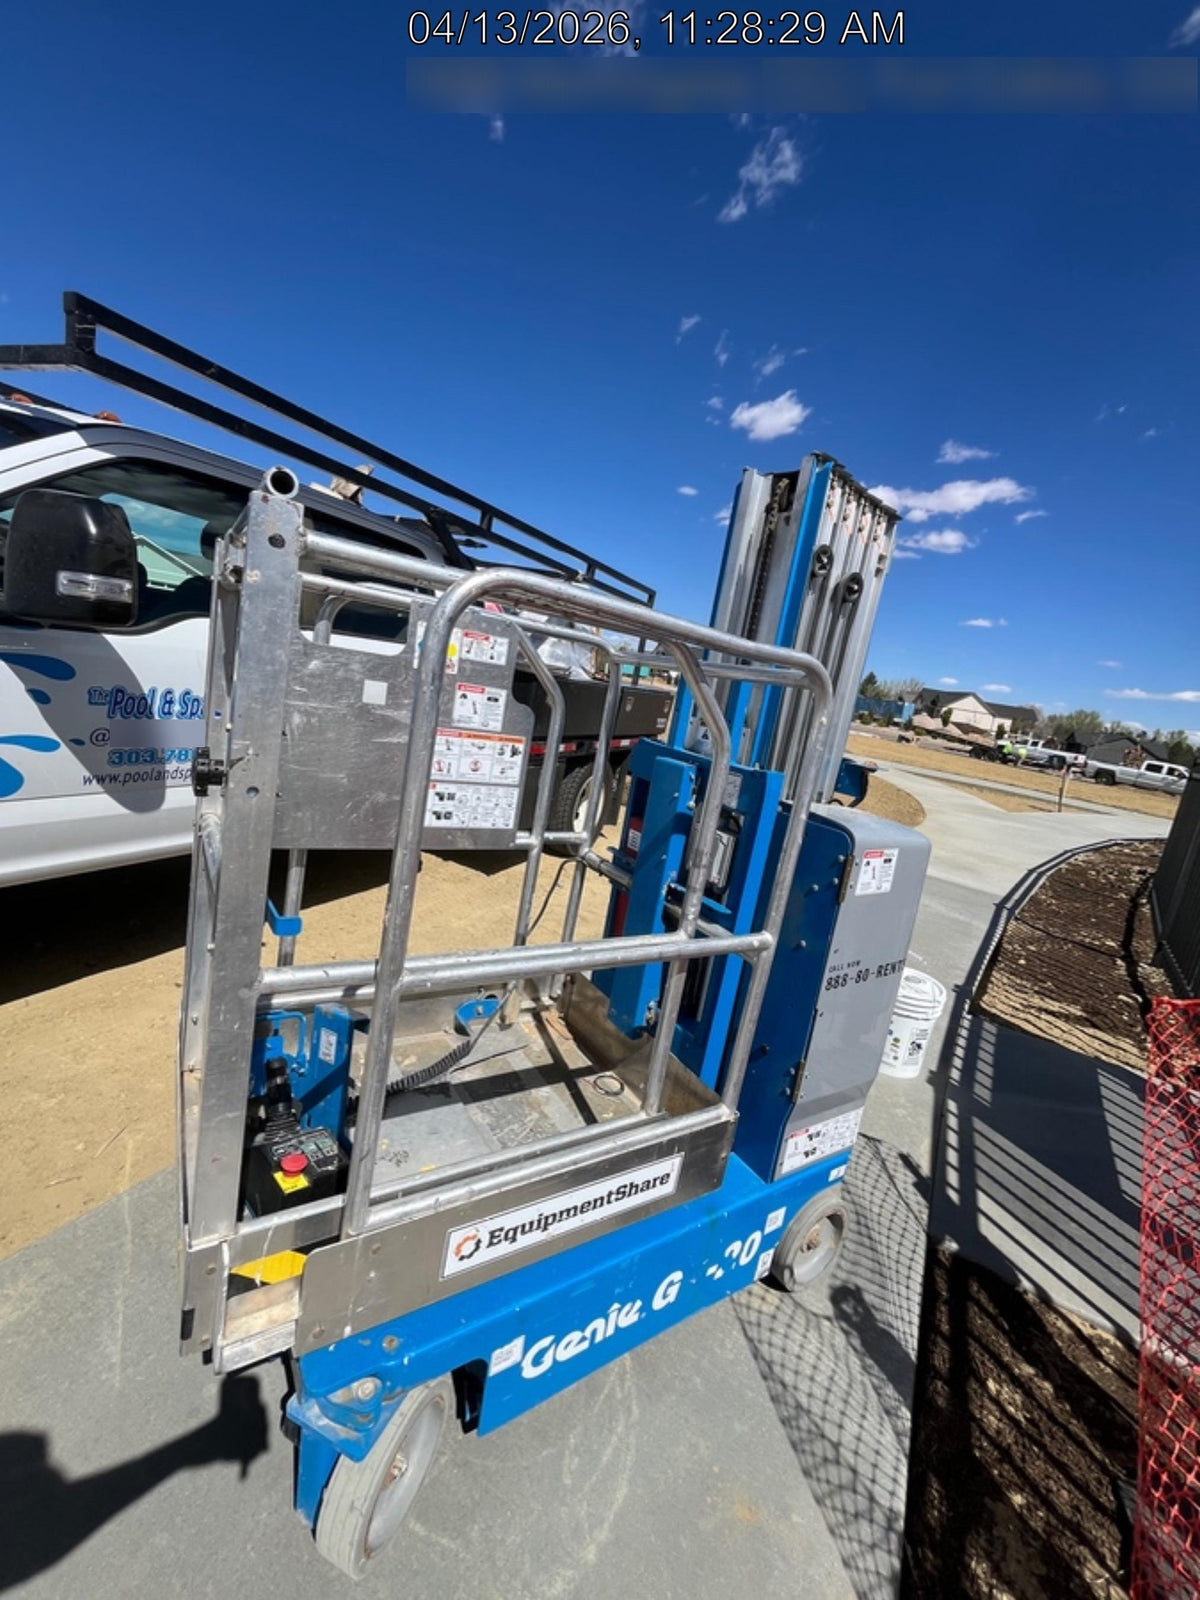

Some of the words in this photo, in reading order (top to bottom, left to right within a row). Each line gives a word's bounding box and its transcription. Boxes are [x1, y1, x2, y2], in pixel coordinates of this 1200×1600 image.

[112, 687, 155, 717] Pool
[161, 688, 174, 716] &
[180, 690, 204, 720] Sp
[486, 1172, 670, 1249] EquipmentShare
